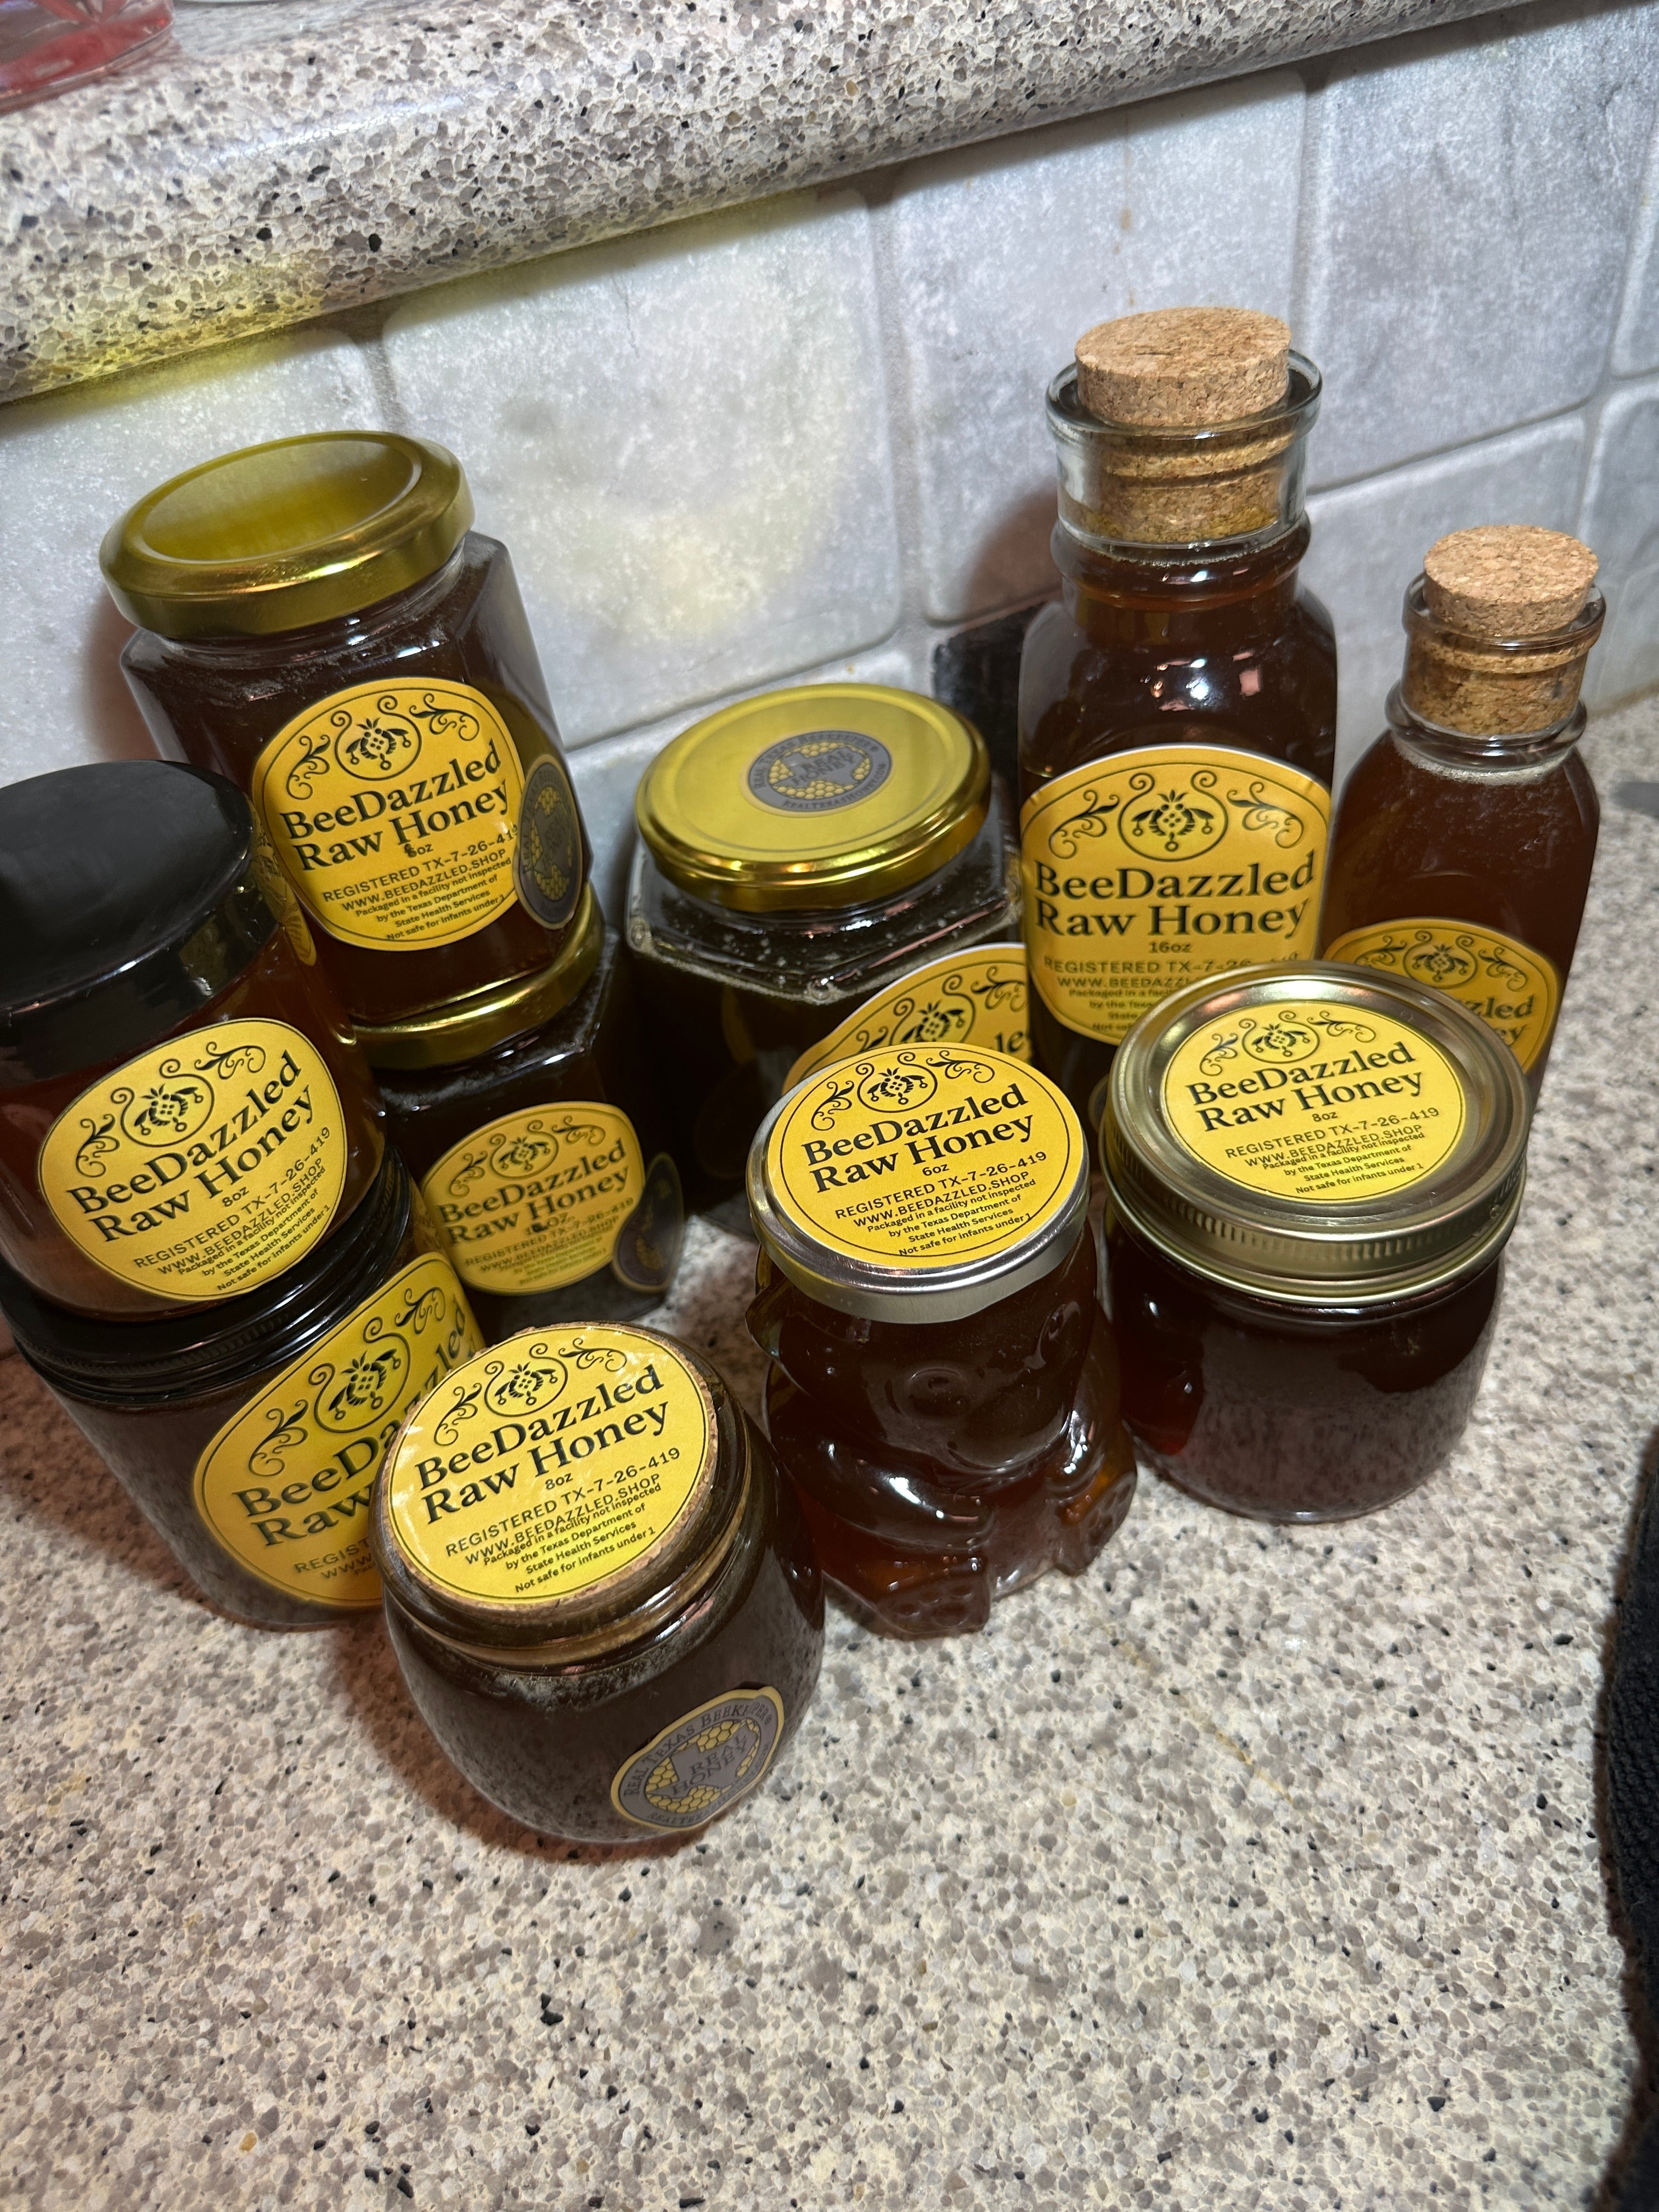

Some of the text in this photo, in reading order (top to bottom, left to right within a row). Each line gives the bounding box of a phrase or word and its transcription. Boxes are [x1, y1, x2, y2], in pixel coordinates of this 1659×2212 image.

[279, 739, 501, 840] BeeDazzled
[291, 831, 382, 872] Raw
[388, 778, 507, 845] Honey
[321, 866, 419, 902] REGISTERED
[341, 848, 505, 911] WWW.BEEDAZZLED.SHOP
[355, 898, 399, 917] Packaged
[418, 882, 450, 897] facility
[452, 876, 467, 885] not
[468, 857, 513, 879] inspected
[376, 874, 497, 922] by the Texas Department of
[1034, 849, 1314, 899] BeeDazzled
[1035, 897, 1310, 939] Raw Honey
[1149, 941, 1191, 953] 16oz
[1044, 956, 1159, 973] REGISTERED
[1185, 1041, 1415, 1105] BeeDazzled
[1196, 1071, 1421, 1131] Raw Honey
[66, 1049, 301, 1214] BeeDazzled
[800, 1083, 1028, 1166] BeeDazzled
[1224, 1107, 1438, 1158] REGISTERED TX-7-26-419
[1244, 1124, 1421, 1166] WWW.BEEDAZZLED.SHOP
[1312, 1111, 1338, 1122] 8oz
[88, 1085, 312, 1242] Raw Honey
[439, 1138, 626, 1224] BeeDazzled
[809, 1114, 1032, 1193] Raw Honey
[922, 1164, 949, 1176] 6oz
[1262, 1154, 1307, 1170] Packaged
[1326, 1146, 1359, 1156] facility
[1377, 1132, 1425, 1146] inspected
[1304, 1157, 1404, 1181] State Health Services
[1314, 1160, 1341, 1169] Texas
[1342, 1147, 1400, 1163] Department
[1315, 1181, 1335, 1189] safe
[1352, 1171, 1386, 1182] infants
[1387, 1165, 1414, 1175] under
[132, 1126, 330, 1268] REGISTERED TX-7-26-419
[222, 1186, 249, 1207] 8oz
[447, 1211, 520, 1244] Raw
[526, 1166, 629, 1220] Honey
[835, 1151, 1046, 1218] REGISTERED TX-7-26-419
[853, 1171, 1028, 1226] WWW.BEEDAZZLED.SHOP
[867, 1214, 913, 1232] Packaged
[934, 1200, 967, 1214] facility
[970, 1194, 988, 1203] not
[988, 1178, 1036, 1198] inspected
[921, 1217, 949, 1228] Texas
[950, 1199, 1009, 1220] Department
[1011, 1193, 1020, 1202] of
[157, 1158, 323, 1274] WWW.BEEDAZZLED.SHOP
[177, 1165, 325, 1275] Packaged in a facility not inspected
[201, 1188, 318, 1276] by the Texas Department of
[223, 1207, 315, 1276] State Health Services
[899, 1212, 1032, 1256] Not safe for infants under 1
[908, 1209, 1013, 1242] State Health Services
[217, 1279, 236, 1290] Not
[236, 1267, 257, 1280] safe
[257, 1256, 271, 1268] for
[271, 1233, 302, 1257] infants
[302, 1210, 324, 1233] under
[414, 1364, 664, 1491] BeeDazzled
[421, 1401, 668, 1524] Raw Honey
[545, 1472, 573, 1490] 8oz
[445, 1447, 679, 1556] REGISTERED TX-7-26-419
[465, 1473, 659, 1564] WWW.BEEDAZZLED.SHOP
[483, 1537, 532, 1565] Packaged
[534, 1534, 544, 1543] in
[554, 1515, 590, 1534] facility
[592, 1506, 610, 1519] not
[611, 1482, 661, 1510] inspected
[294, 1537, 370, 1573] REGIST
[505, 1502, 645, 1570] by the Texas Department of
[515, 1526, 655, 1593] Not safe for infants under 1
[526, 1521, 636, 1574] State Health Services
[624, 1767, 649, 1796] REAL
[642, 1725, 695, 1763] TEXAS
